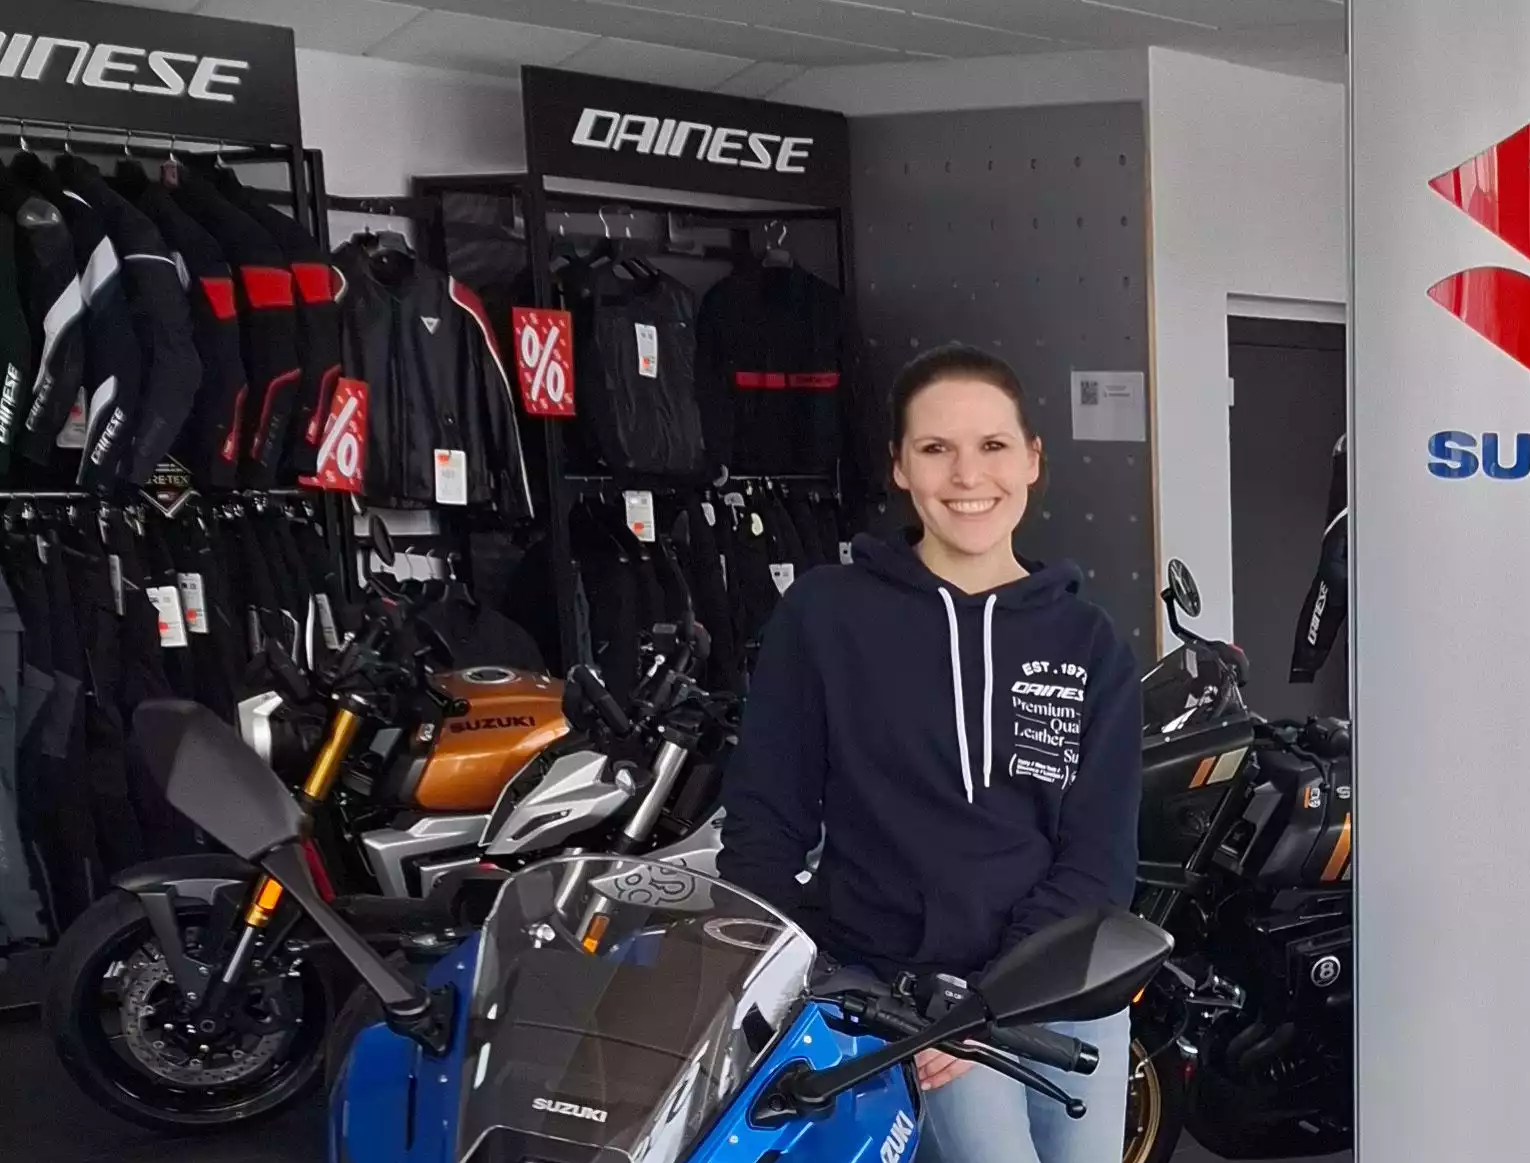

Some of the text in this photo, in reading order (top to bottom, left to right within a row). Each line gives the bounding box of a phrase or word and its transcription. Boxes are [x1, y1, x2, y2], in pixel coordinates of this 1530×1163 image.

[0, 31, 249, 102] INESE
[572, 107, 813, 173] DAINESE
[144, 473, 190, 486] RE-TEX
[1012, 695, 1076, 719] Premium
[449, 716, 536, 734] SUZUKI
[1014, 721, 1065, 748] Leather
[1050, 718, 1082, 735] Qua
[531, 1097, 608, 1123] SUZUKI
